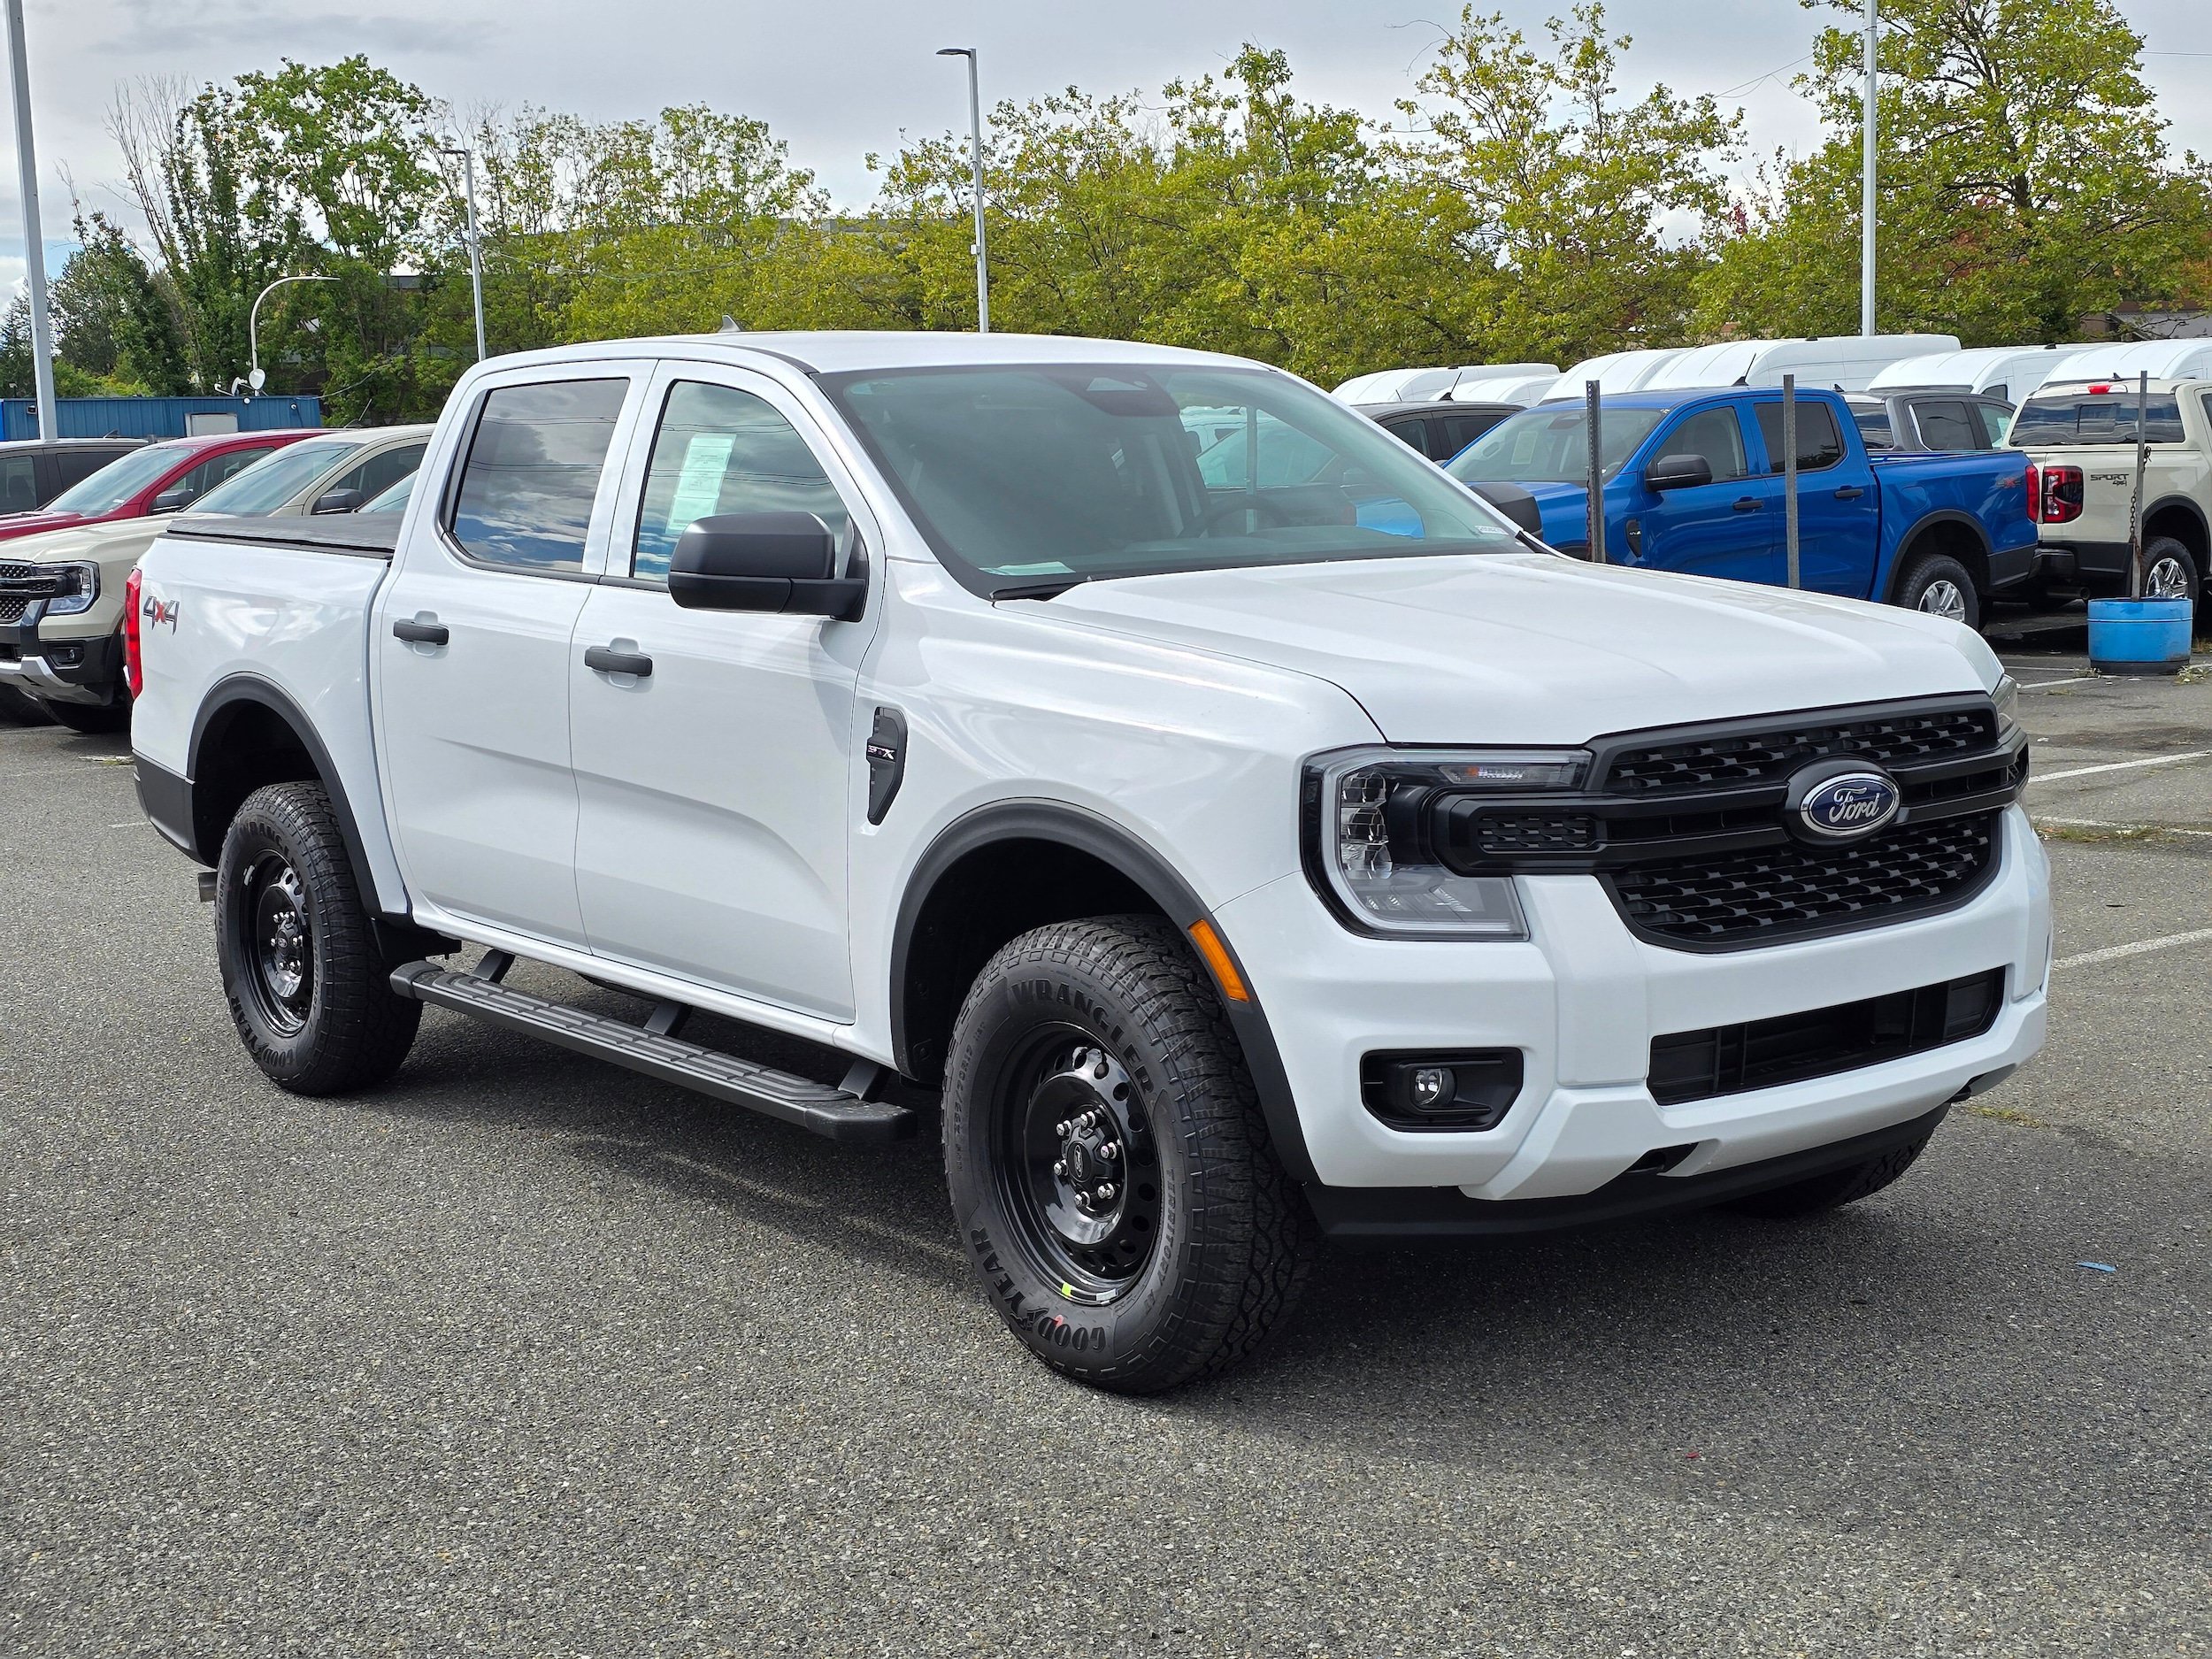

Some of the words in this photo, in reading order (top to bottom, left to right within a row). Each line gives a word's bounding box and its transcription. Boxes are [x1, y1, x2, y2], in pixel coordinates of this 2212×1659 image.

[143, 595, 180, 636] 4x4
[1828, 787, 1881, 823] Ford
[230, 995, 295, 1068] GOODYEAR
[1010, 978, 1155, 1095] WRANGLER
[1156, 1167, 1176, 1286] TERRITORY
[970, 1225, 1106, 1353] GOODYEAR
